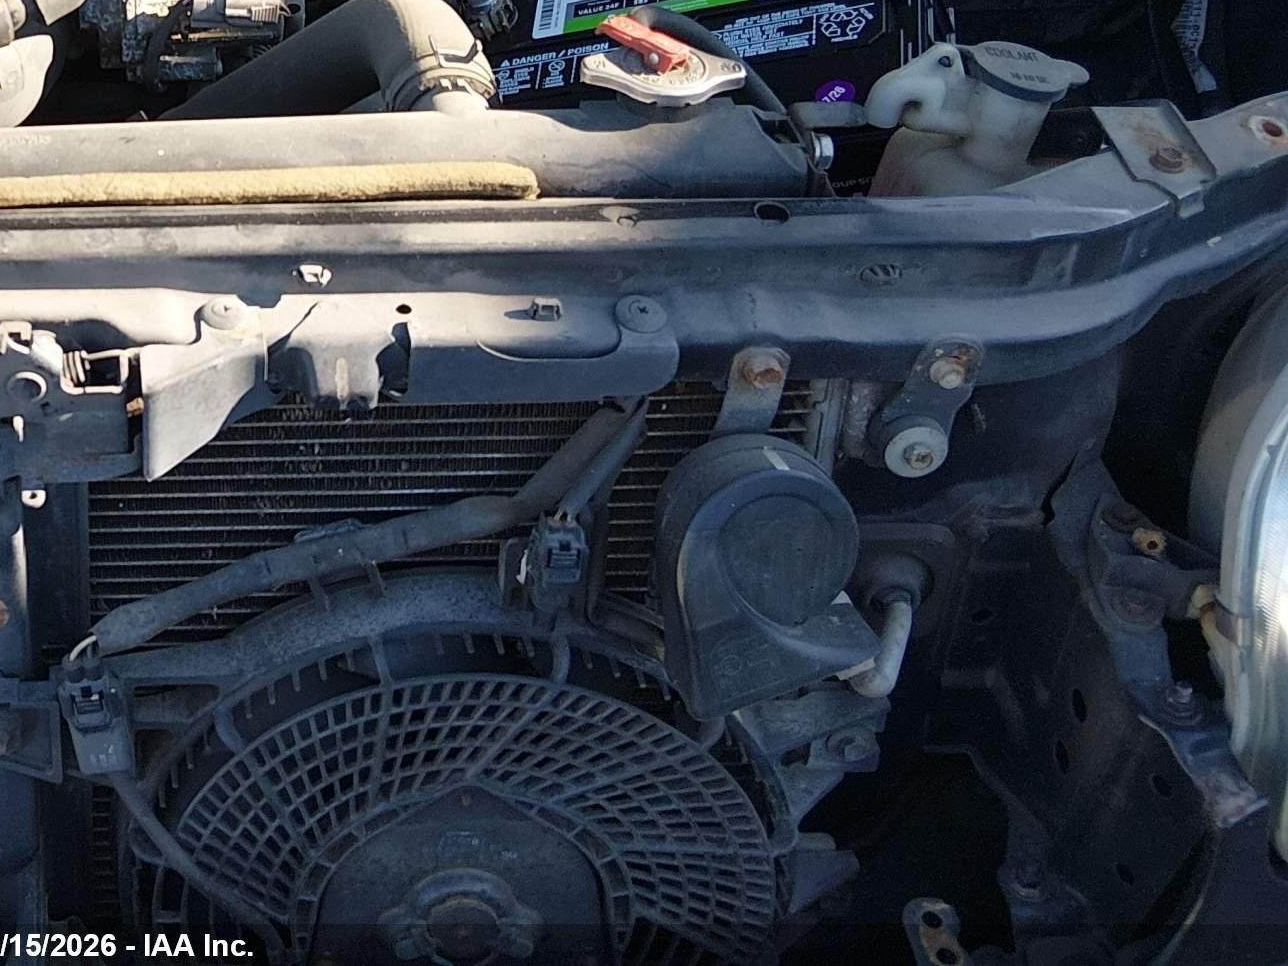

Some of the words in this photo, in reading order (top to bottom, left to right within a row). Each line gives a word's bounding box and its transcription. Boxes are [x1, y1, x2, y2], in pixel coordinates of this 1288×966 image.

[578, 5, 603, 15] VALUE
[511, 51, 557, 65] DANGER
[557, 50, 567, 58] /
[566, 42, 610, 56] POISON
